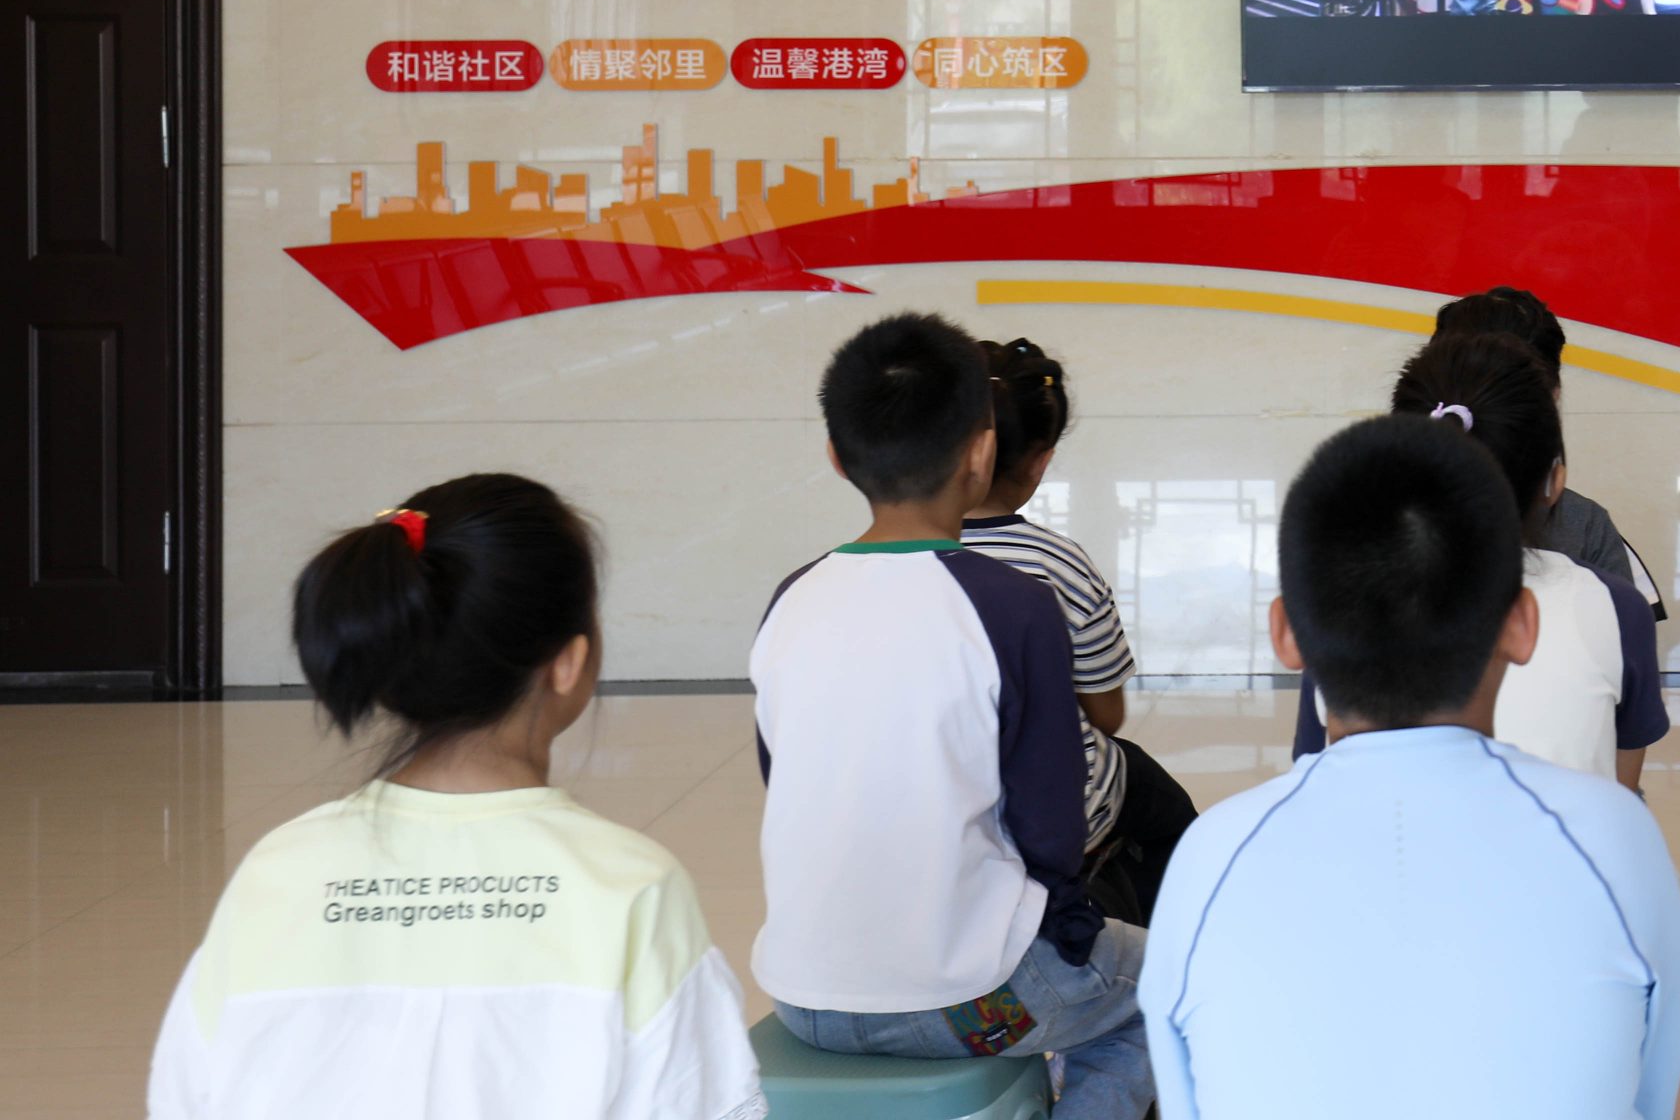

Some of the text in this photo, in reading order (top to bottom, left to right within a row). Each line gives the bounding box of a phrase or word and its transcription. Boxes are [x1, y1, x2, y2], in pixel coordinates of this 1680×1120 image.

[388, 50, 525, 82] 和谐社区
[570, 48, 706, 80] 情聚邻里
[752, 47, 888, 79] 温馨港湾
[934, 46, 1068, 78] 同心筑区
[324, 898, 546, 926] Greangroets shop
